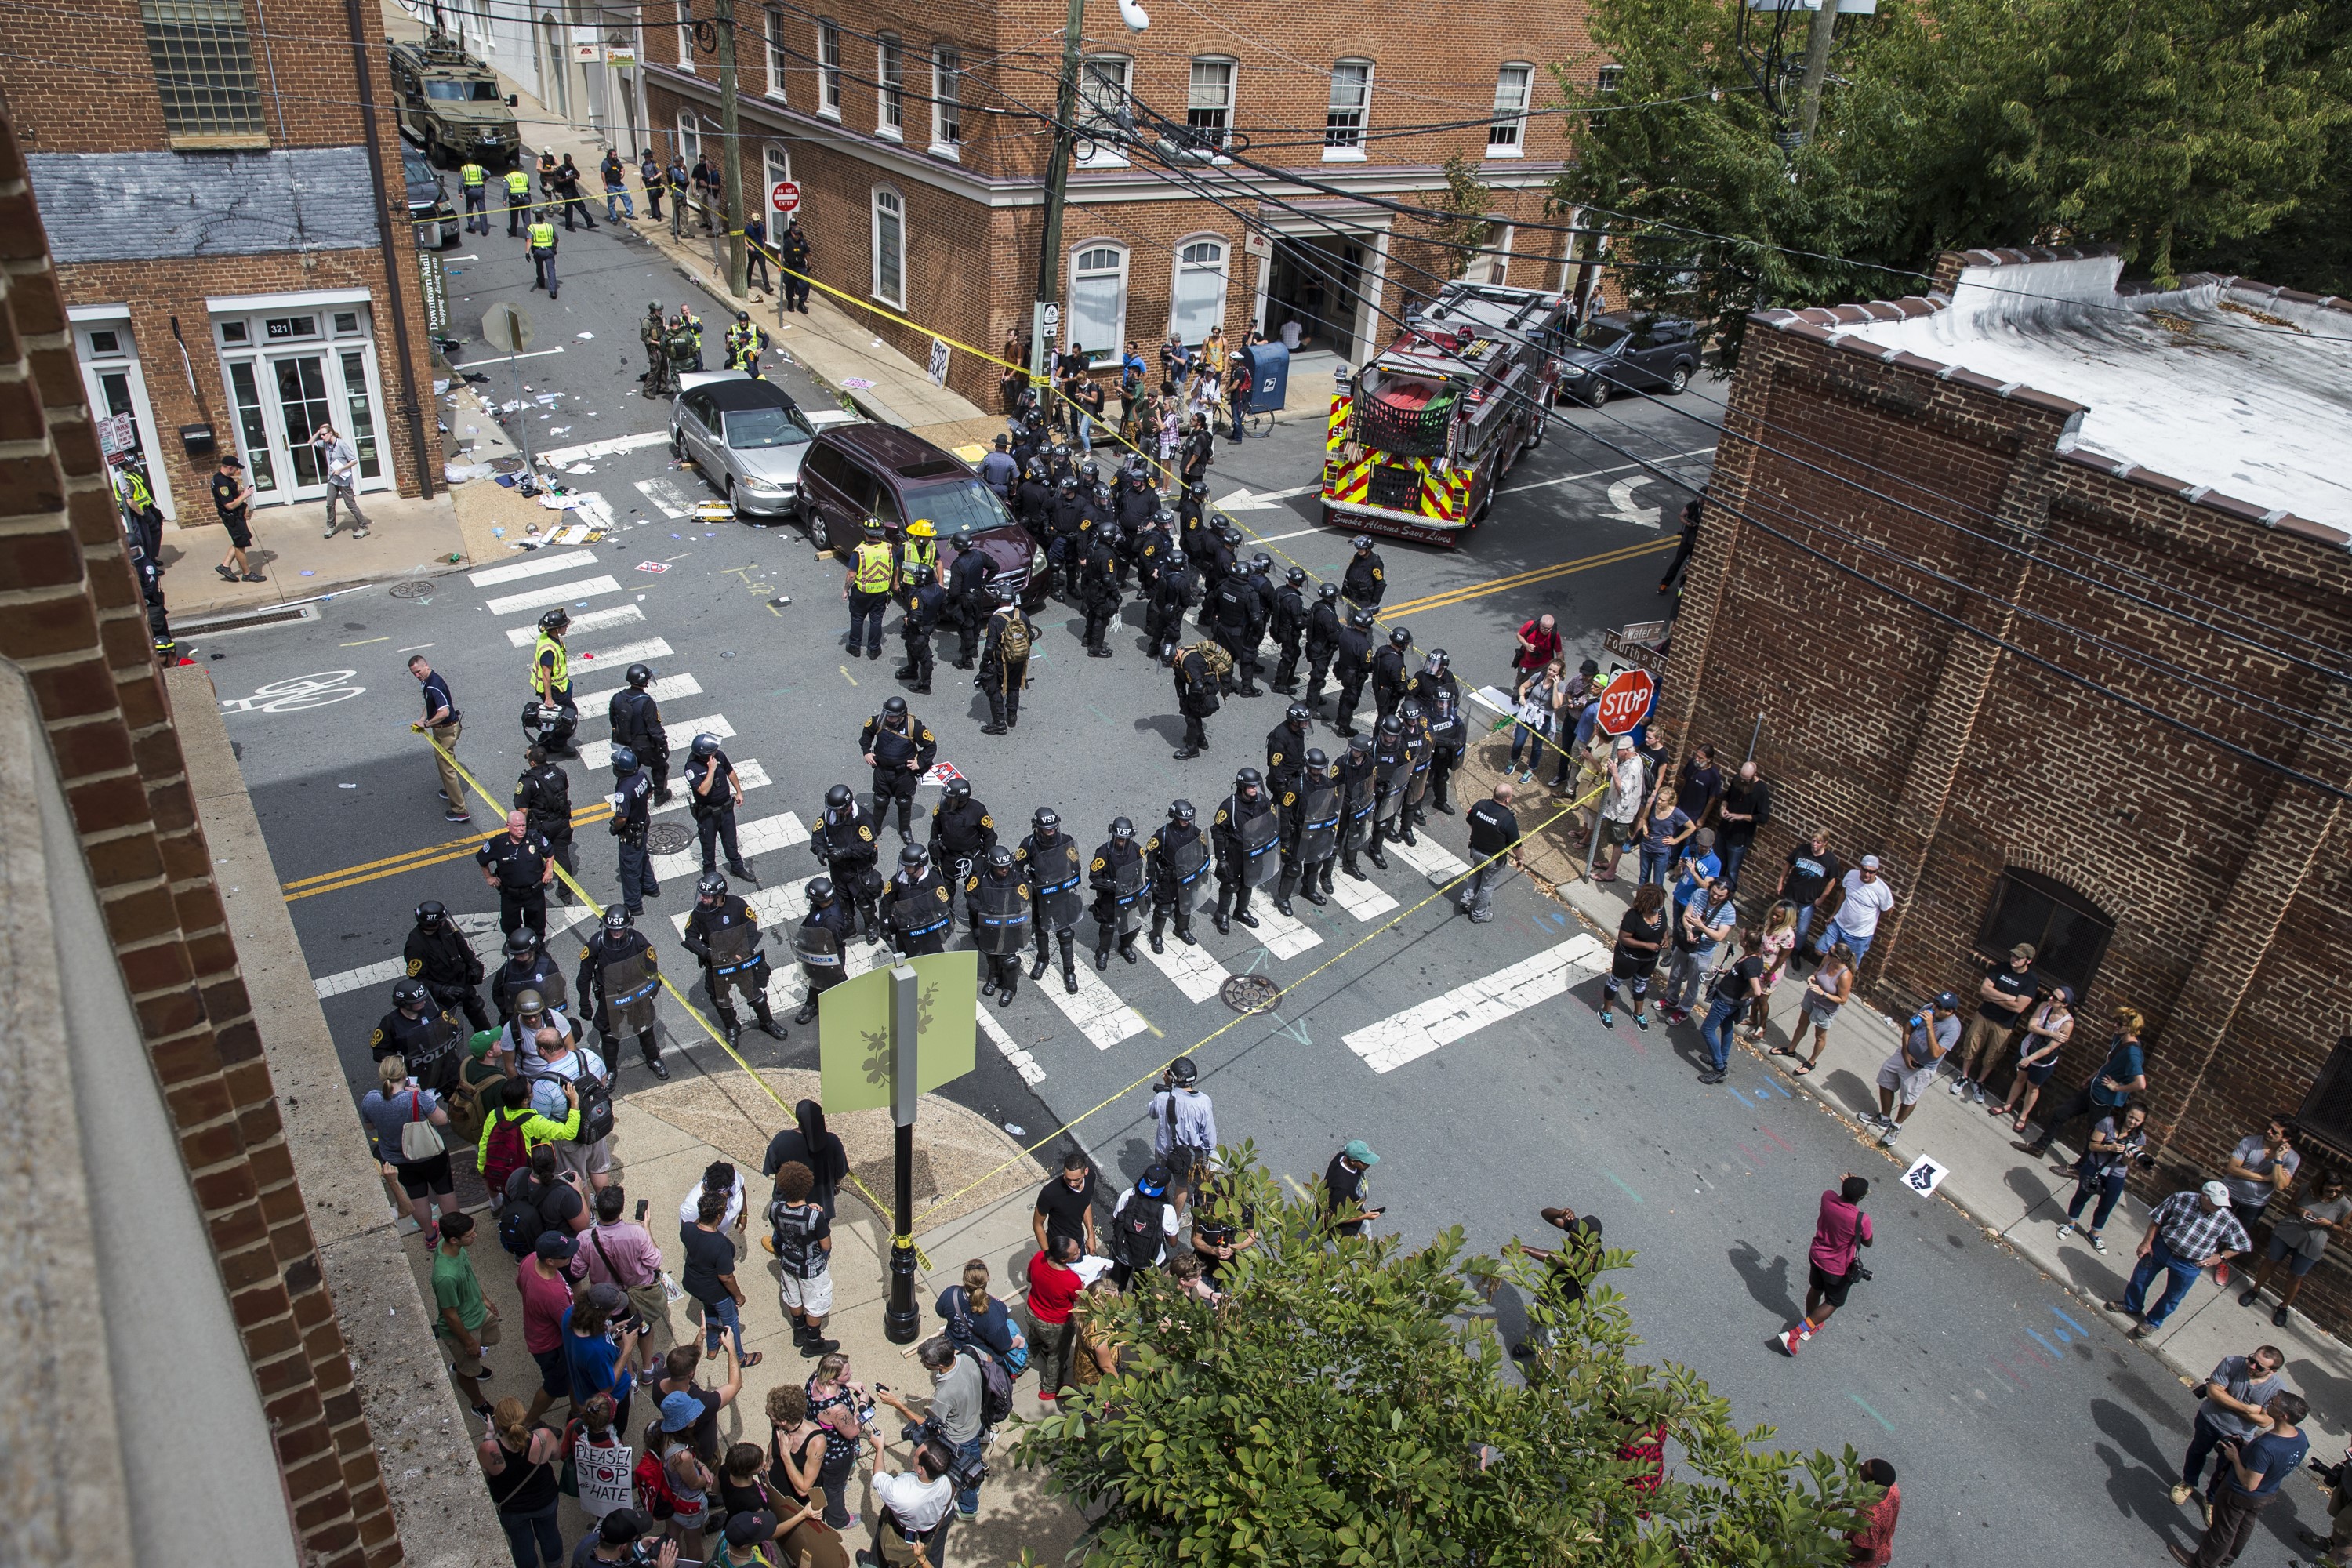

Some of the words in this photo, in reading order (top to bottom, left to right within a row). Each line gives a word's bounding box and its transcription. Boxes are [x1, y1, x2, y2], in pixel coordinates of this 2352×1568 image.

[419, 254, 432, 277] Mall
[426, 278, 438, 331] Downtown
[437, 299, 446, 325] shopping
[270, 325, 288, 333] 321
[934, 342, 947, 363] PRO
[930, 355, 946, 384] BLACK
[115, 423, 130, 432] PARKING
[1333, 426, 1343, 437] E5
[1332, 514, 1362, 527] Smoke
[1364, 519, 1399, 533] Alarms
[1401, 525, 1424, 539] Save
[1426, 532, 1451, 543] Lives
[1223, 593, 1236, 603] POLICE
[1627, 627, 1651, 640] Water
[1606, 634, 1640, 660] Fourth
[1650, 659, 1665, 673] SE
[1603, 688, 1649, 716] STOP
[1434, 721, 1450, 731] POLICE
[1041, 815, 1055, 823] VSP
[1325, 818, 1338, 827] POLICE
[1476, 811, 1497, 826] POLICE
[1267, 837, 1279, 849] POLICE
[996, 855, 1010, 864] VSP
[1182, 874, 1196, 884] STATE
[1200, 859, 1210, 873] POLICE
[1064, 877, 1078, 887] POLICE
[608, 916, 624, 925] VSP
[930, 920, 946, 931] POLICE
[743, 957, 759, 968] POLICE
[616, 996, 631, 1005] STATE
[639, 983, 653, 996] POLICE
[412, 1032, 463, 1067] POLICE
[575, 1444, 632, 1465] PLEASE!
[579, 1465, 629, 1484] STOP
[590, 1484, 628, 1502] HATE
